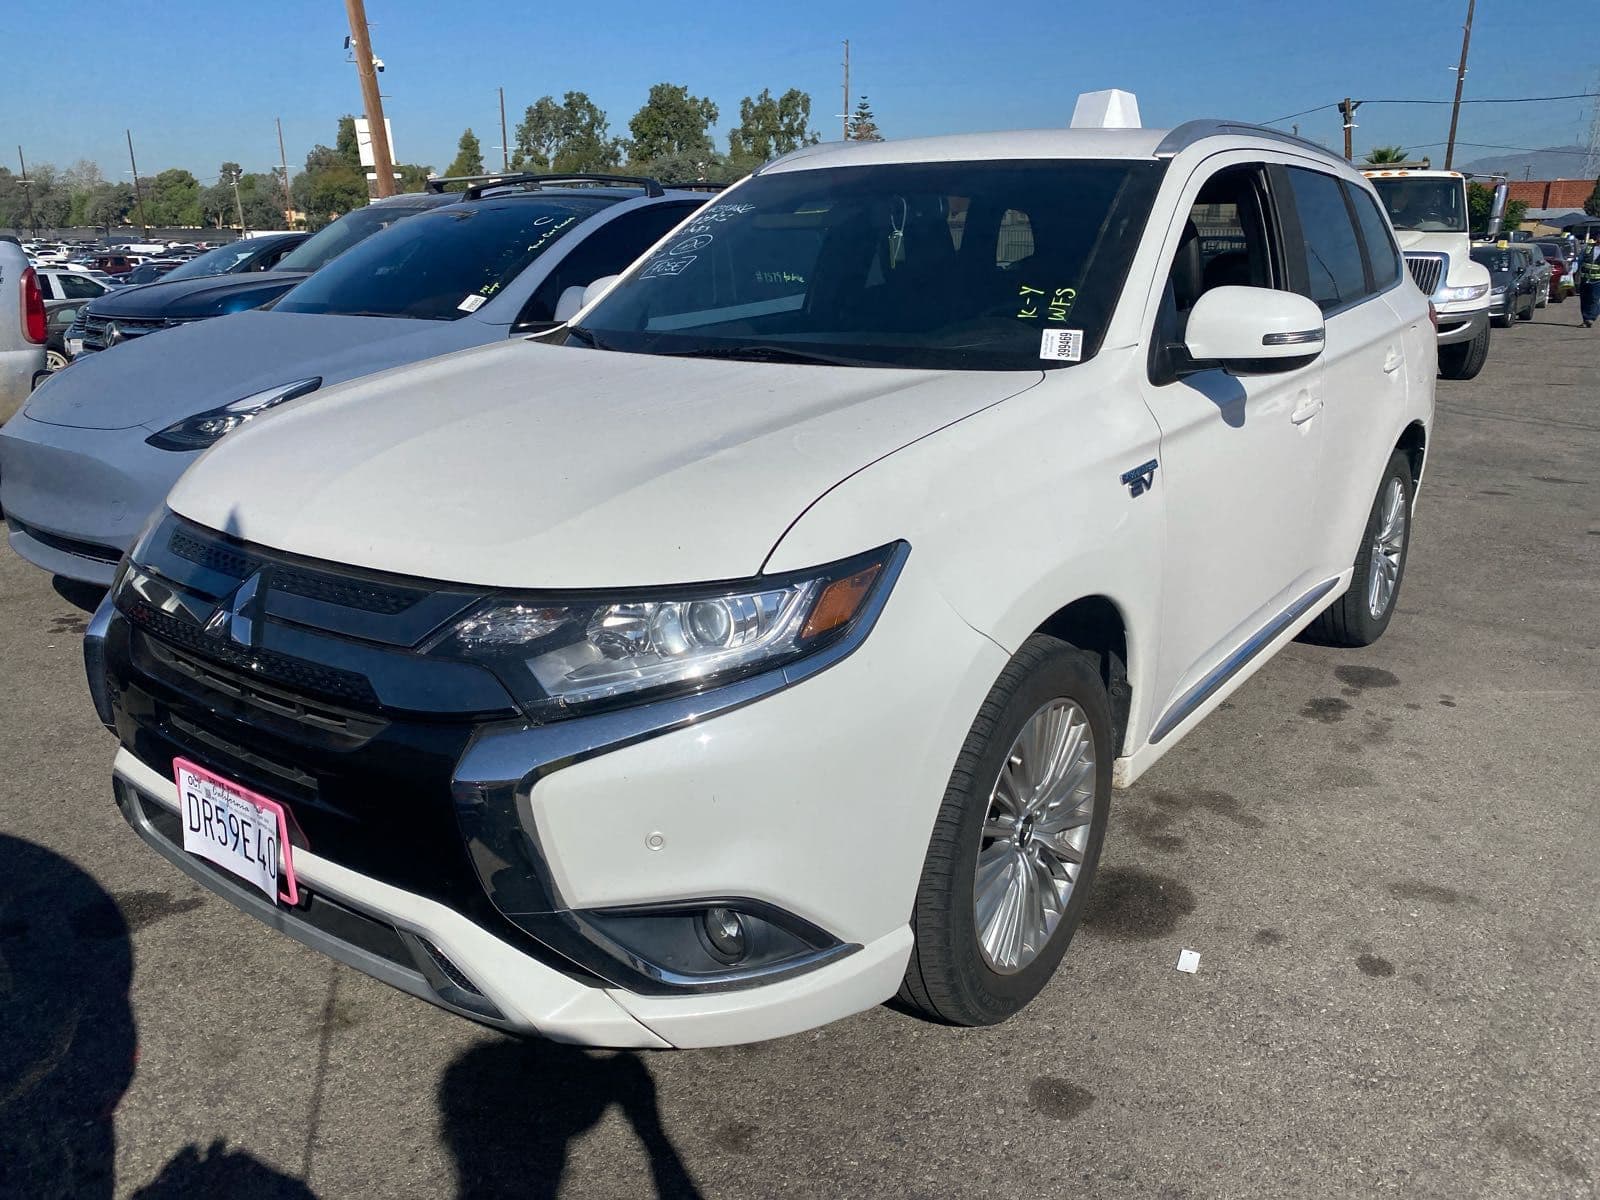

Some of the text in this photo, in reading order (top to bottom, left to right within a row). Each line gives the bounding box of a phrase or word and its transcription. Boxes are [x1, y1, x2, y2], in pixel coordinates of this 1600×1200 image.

[1047, 287, 1076, 322] WFS
[1057, 332, 1072, 358] 399469
[186, 791, 276, 880] DR59E40
